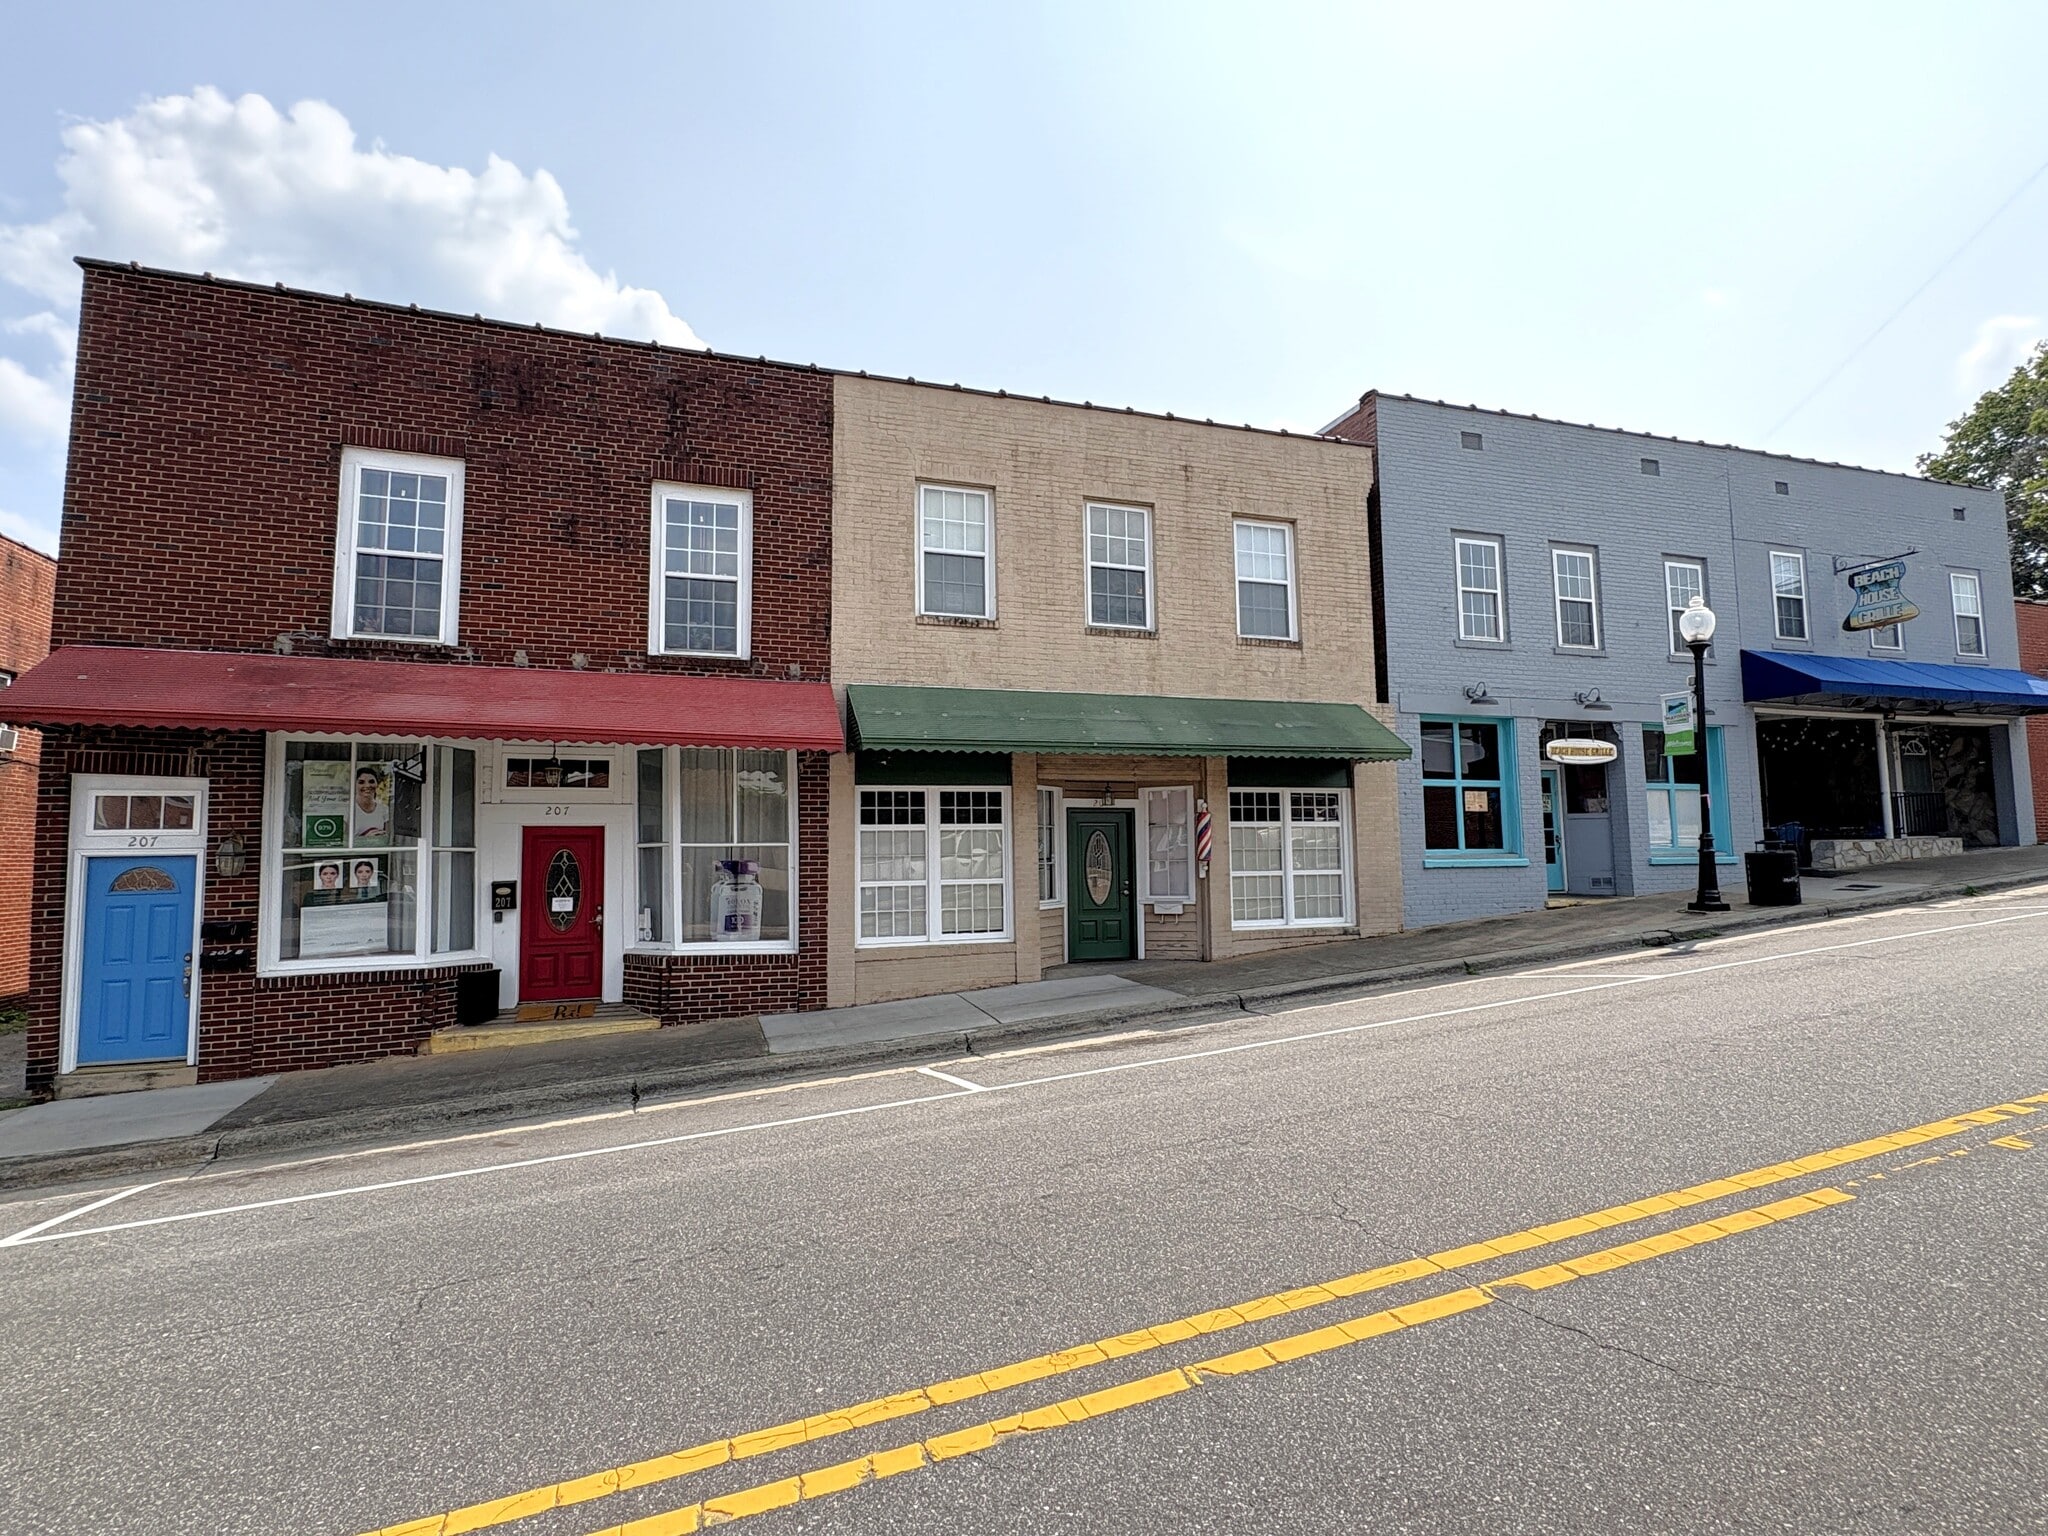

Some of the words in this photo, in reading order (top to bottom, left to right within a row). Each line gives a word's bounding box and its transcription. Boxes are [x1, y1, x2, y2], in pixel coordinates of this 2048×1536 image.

[1854, 567, 1900, 587] BEACH
[1860, 587, 1899, 607] HOUSE
[1859, 603, 1904, 623] GRILLE
[1550, 747, 1569, 756] BEACH
[1570, 747, 1590, 756] HOUSE
[1591, 747, 1614, 756] GRILLE
[545, 806, 570, 816] 207
[128, 836, 159, 848] 207
[495, 897, 511, 908] 207
